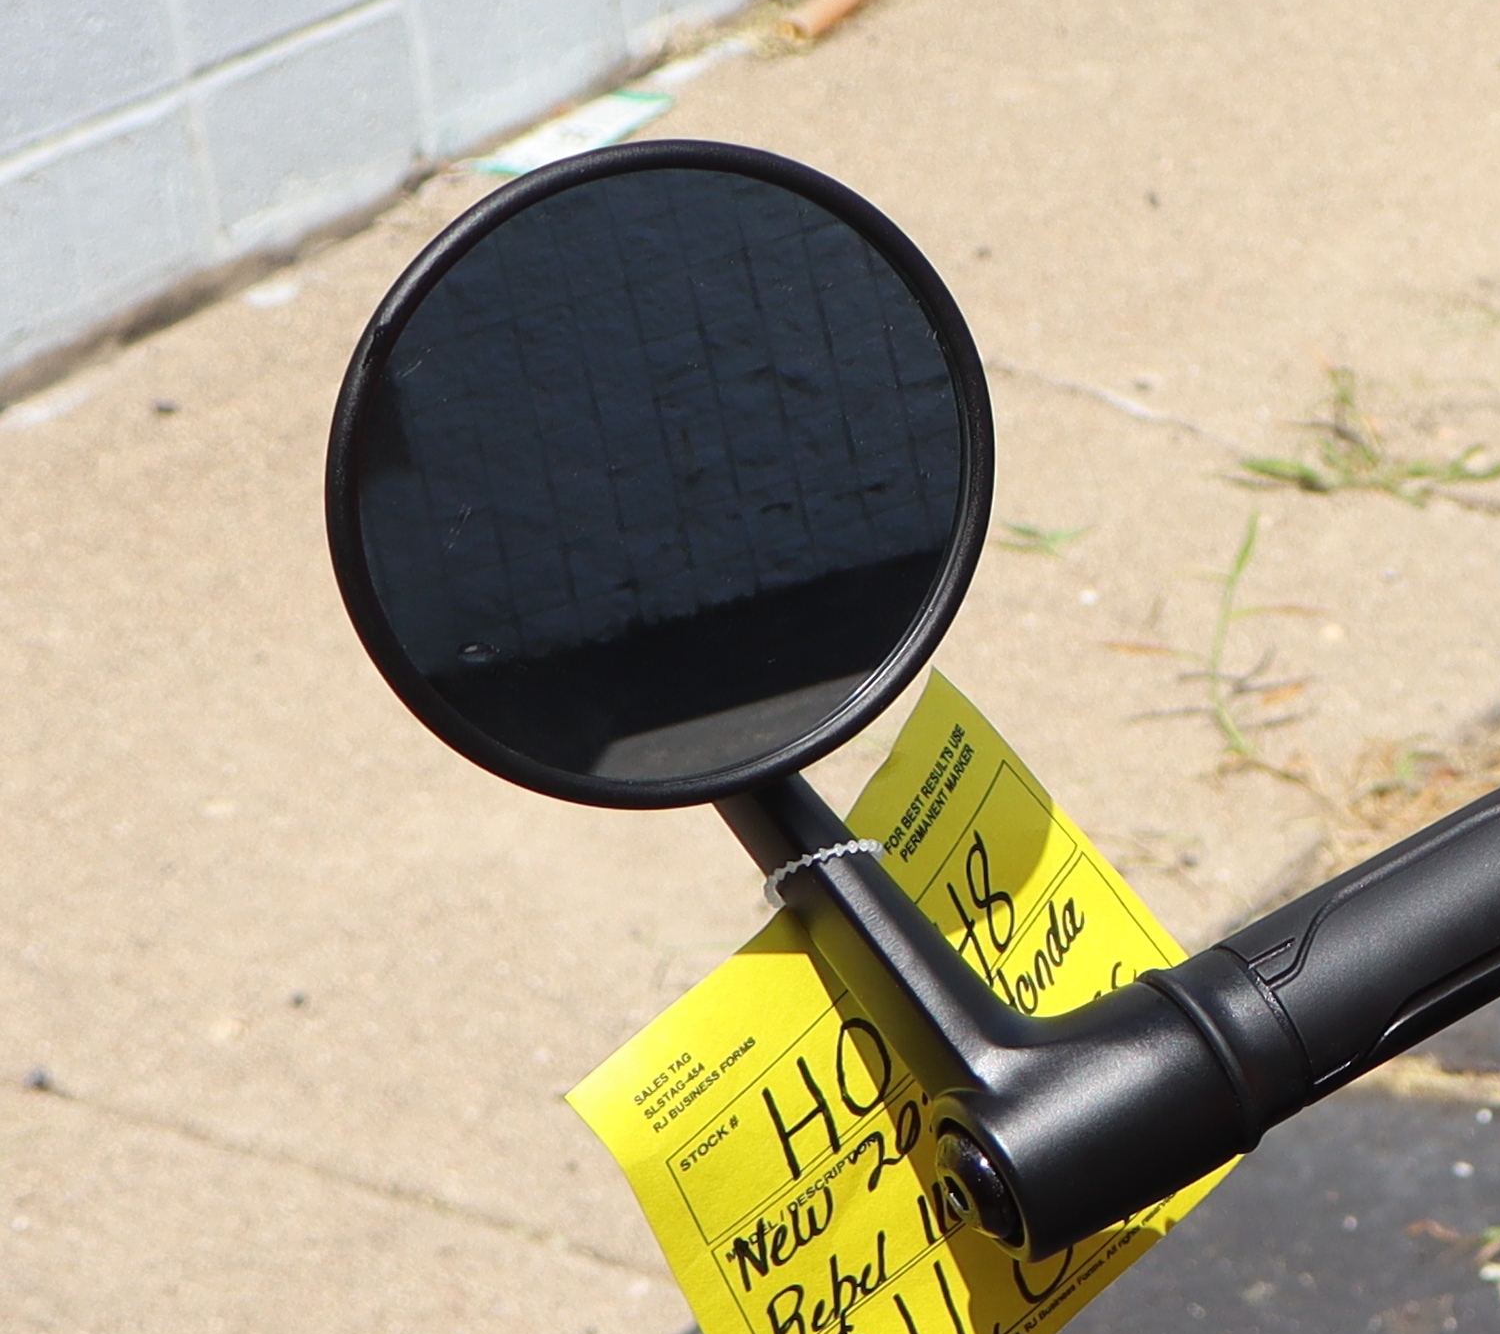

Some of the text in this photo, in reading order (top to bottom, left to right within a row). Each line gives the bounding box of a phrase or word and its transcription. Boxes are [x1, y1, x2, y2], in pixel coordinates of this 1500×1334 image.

[883, 722, 966, 856] FOR BEST RESULTS USE
[899, 742, 976, 863] PERMANENT MARKER
[633, 1051, 692, 1107] SALES TAG
[643, 1061, 706, 1120] SLSTAG-454
[652, 1035, 757, 1134] RJ BUSINESS FORMS
[679, 1114, 740, 1172] STOCK #
[733, 1186, 834, 1293] New
